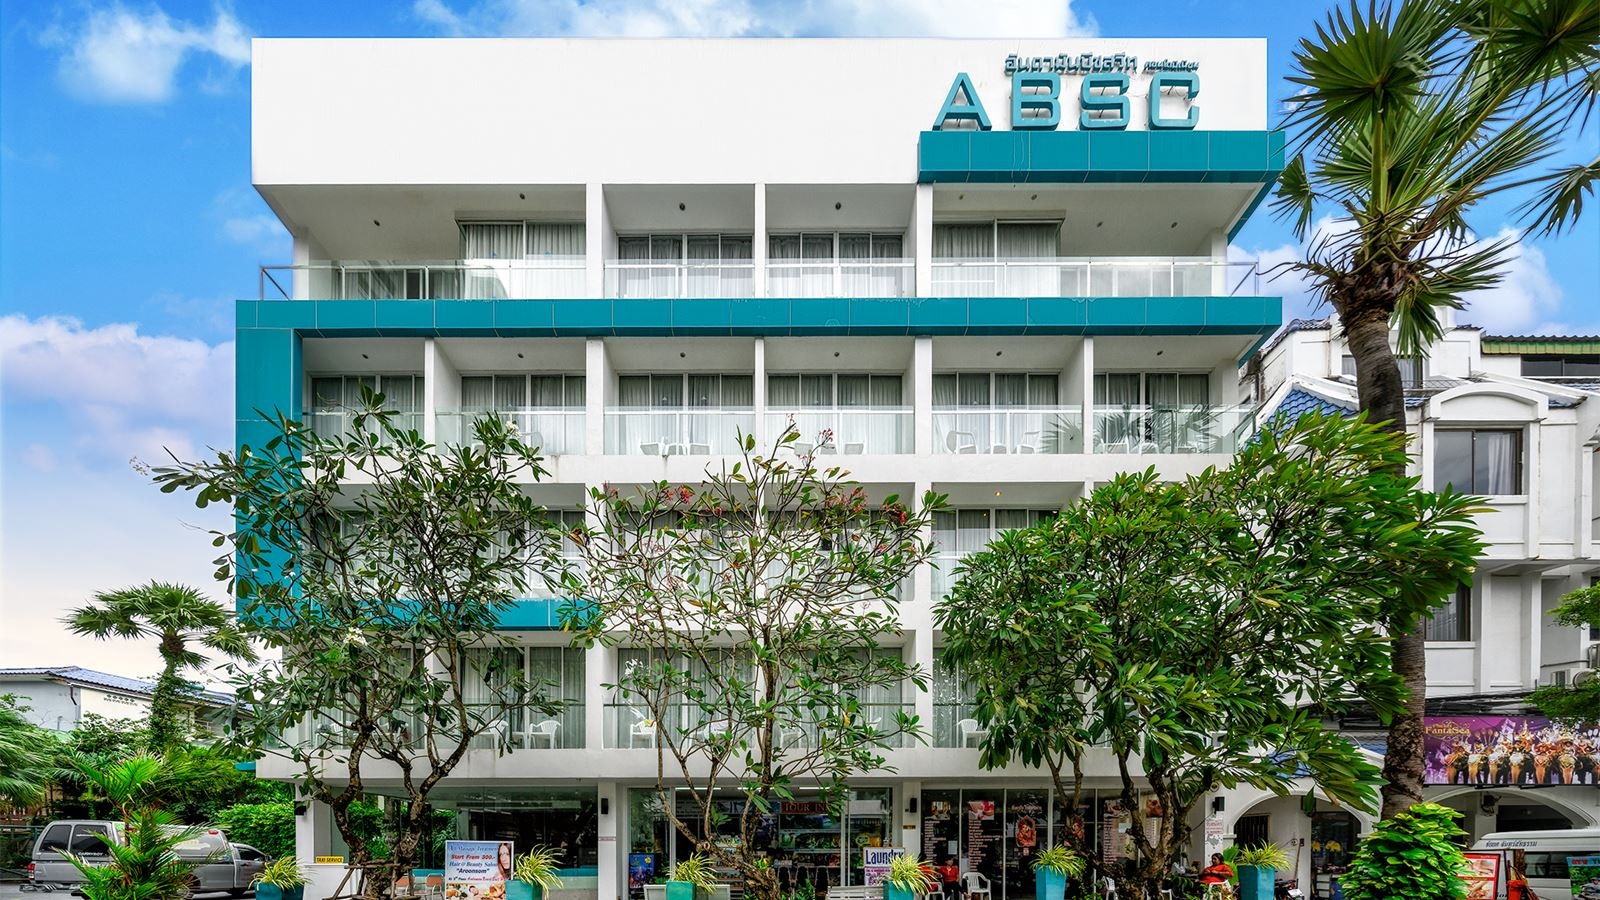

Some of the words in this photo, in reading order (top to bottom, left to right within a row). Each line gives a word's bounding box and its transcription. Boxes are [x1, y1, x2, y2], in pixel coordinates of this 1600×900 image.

[932, 72, 1200, 131] ABSC
[1425, 727, 1471, 735] FantaSea
[785, 802, 810, 812] TOUR
